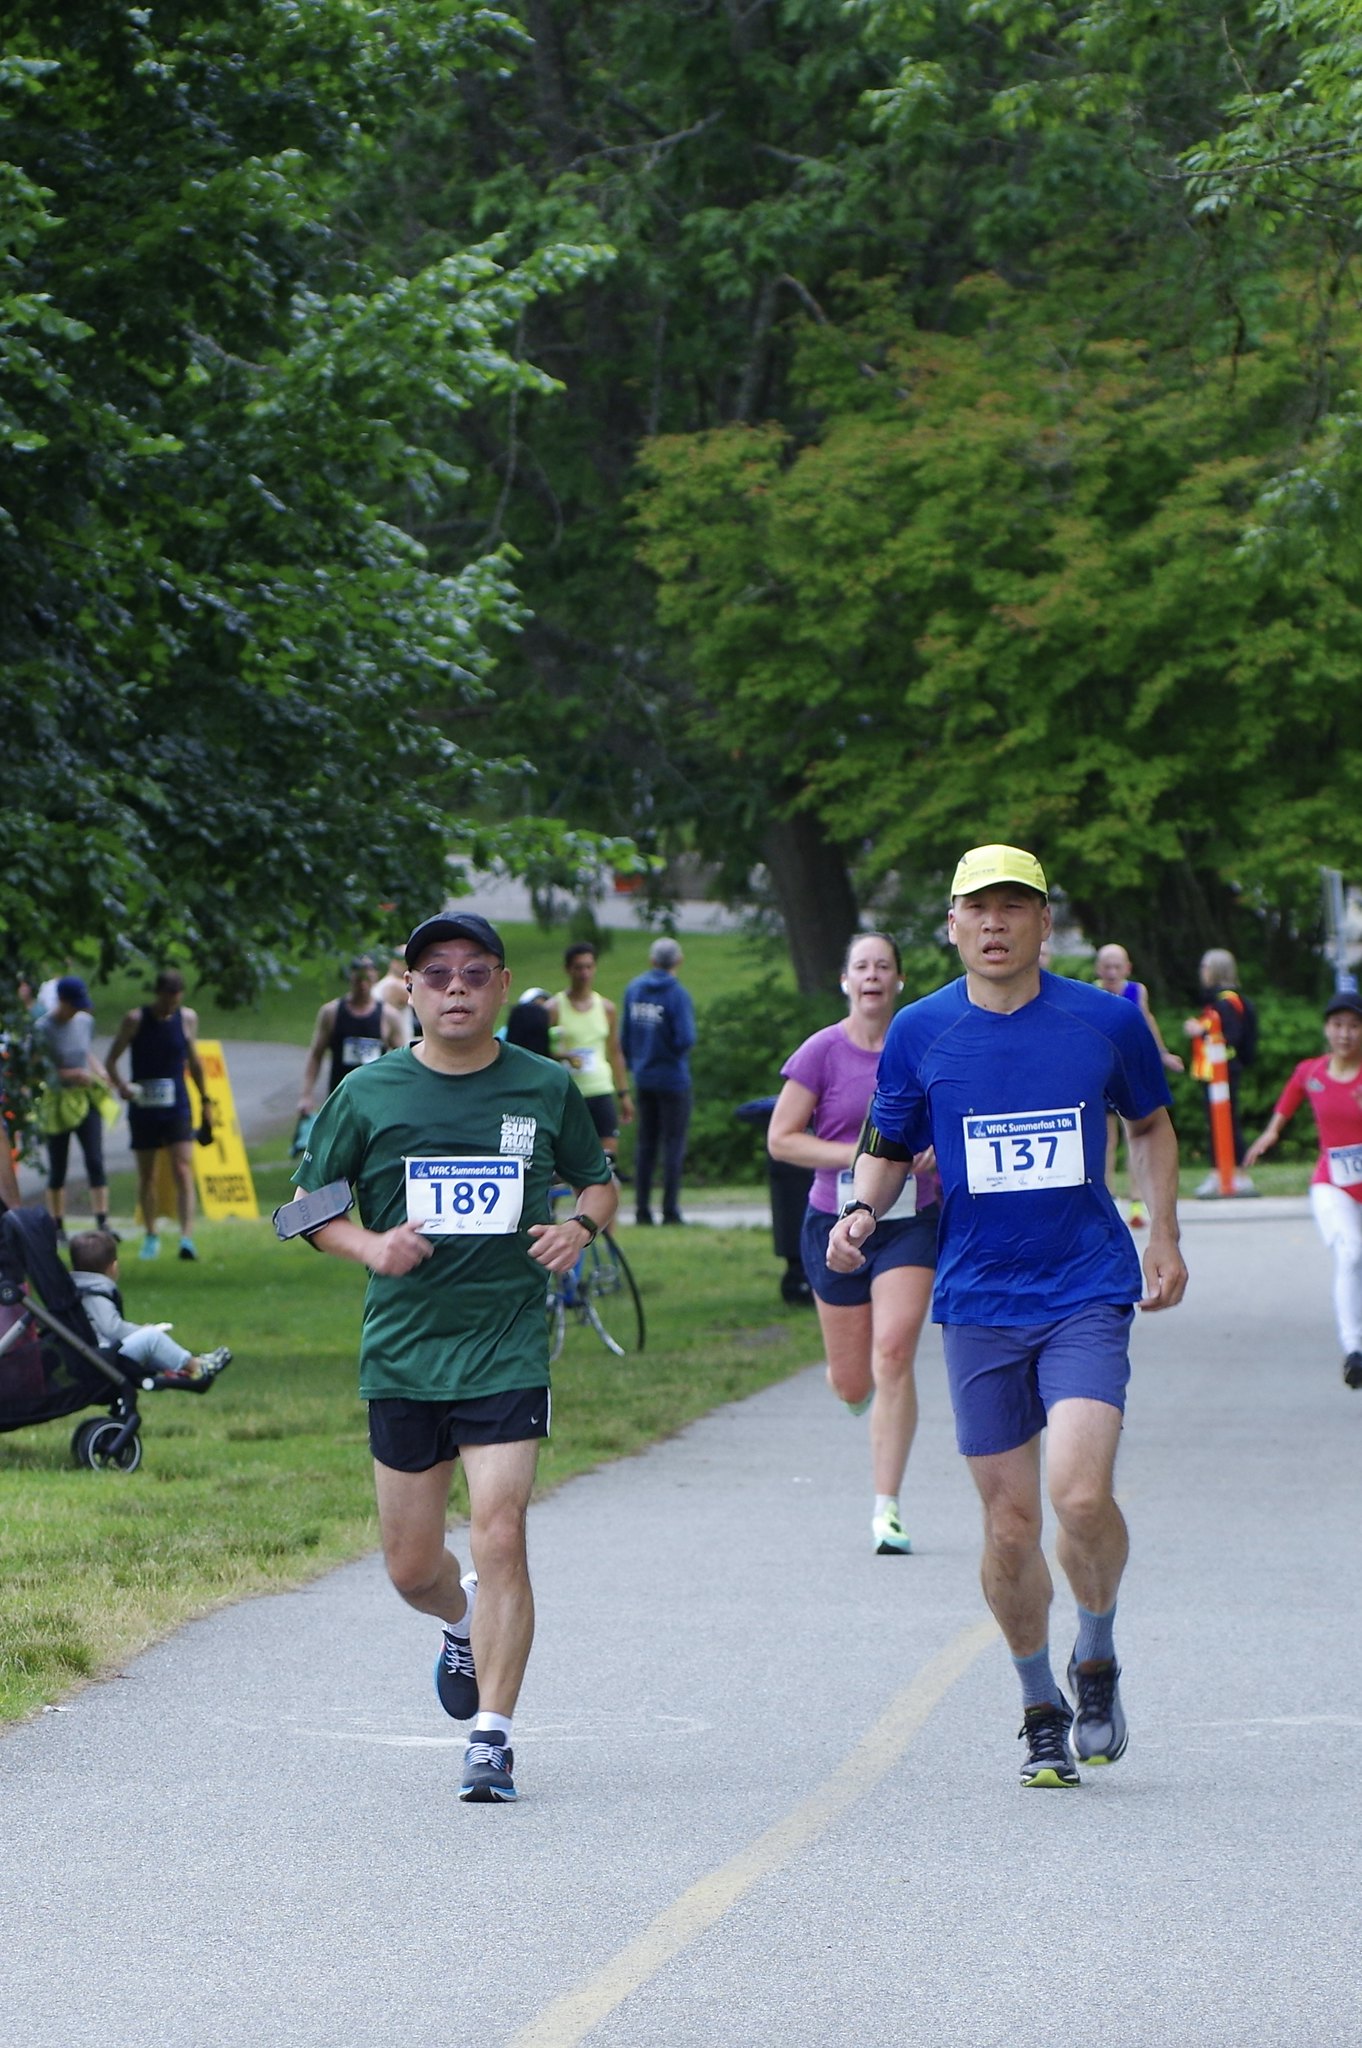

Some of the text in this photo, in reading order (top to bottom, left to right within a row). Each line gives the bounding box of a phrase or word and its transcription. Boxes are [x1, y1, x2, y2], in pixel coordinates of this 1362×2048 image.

[500, 1121, 537, 1137] SUN
[1009, 1119, 1055, 1132] Summerfast
[1056, 1118, 1072, 1128] 10k
[500, 1134, 536, 1149] RUN
[989, 1136, 1058, 1173] 137
[451, 1165, 498, 1176] Summerfast
[499, 1166, 515, 1176] 10k
[431, 1182, 501, 1215] 189
